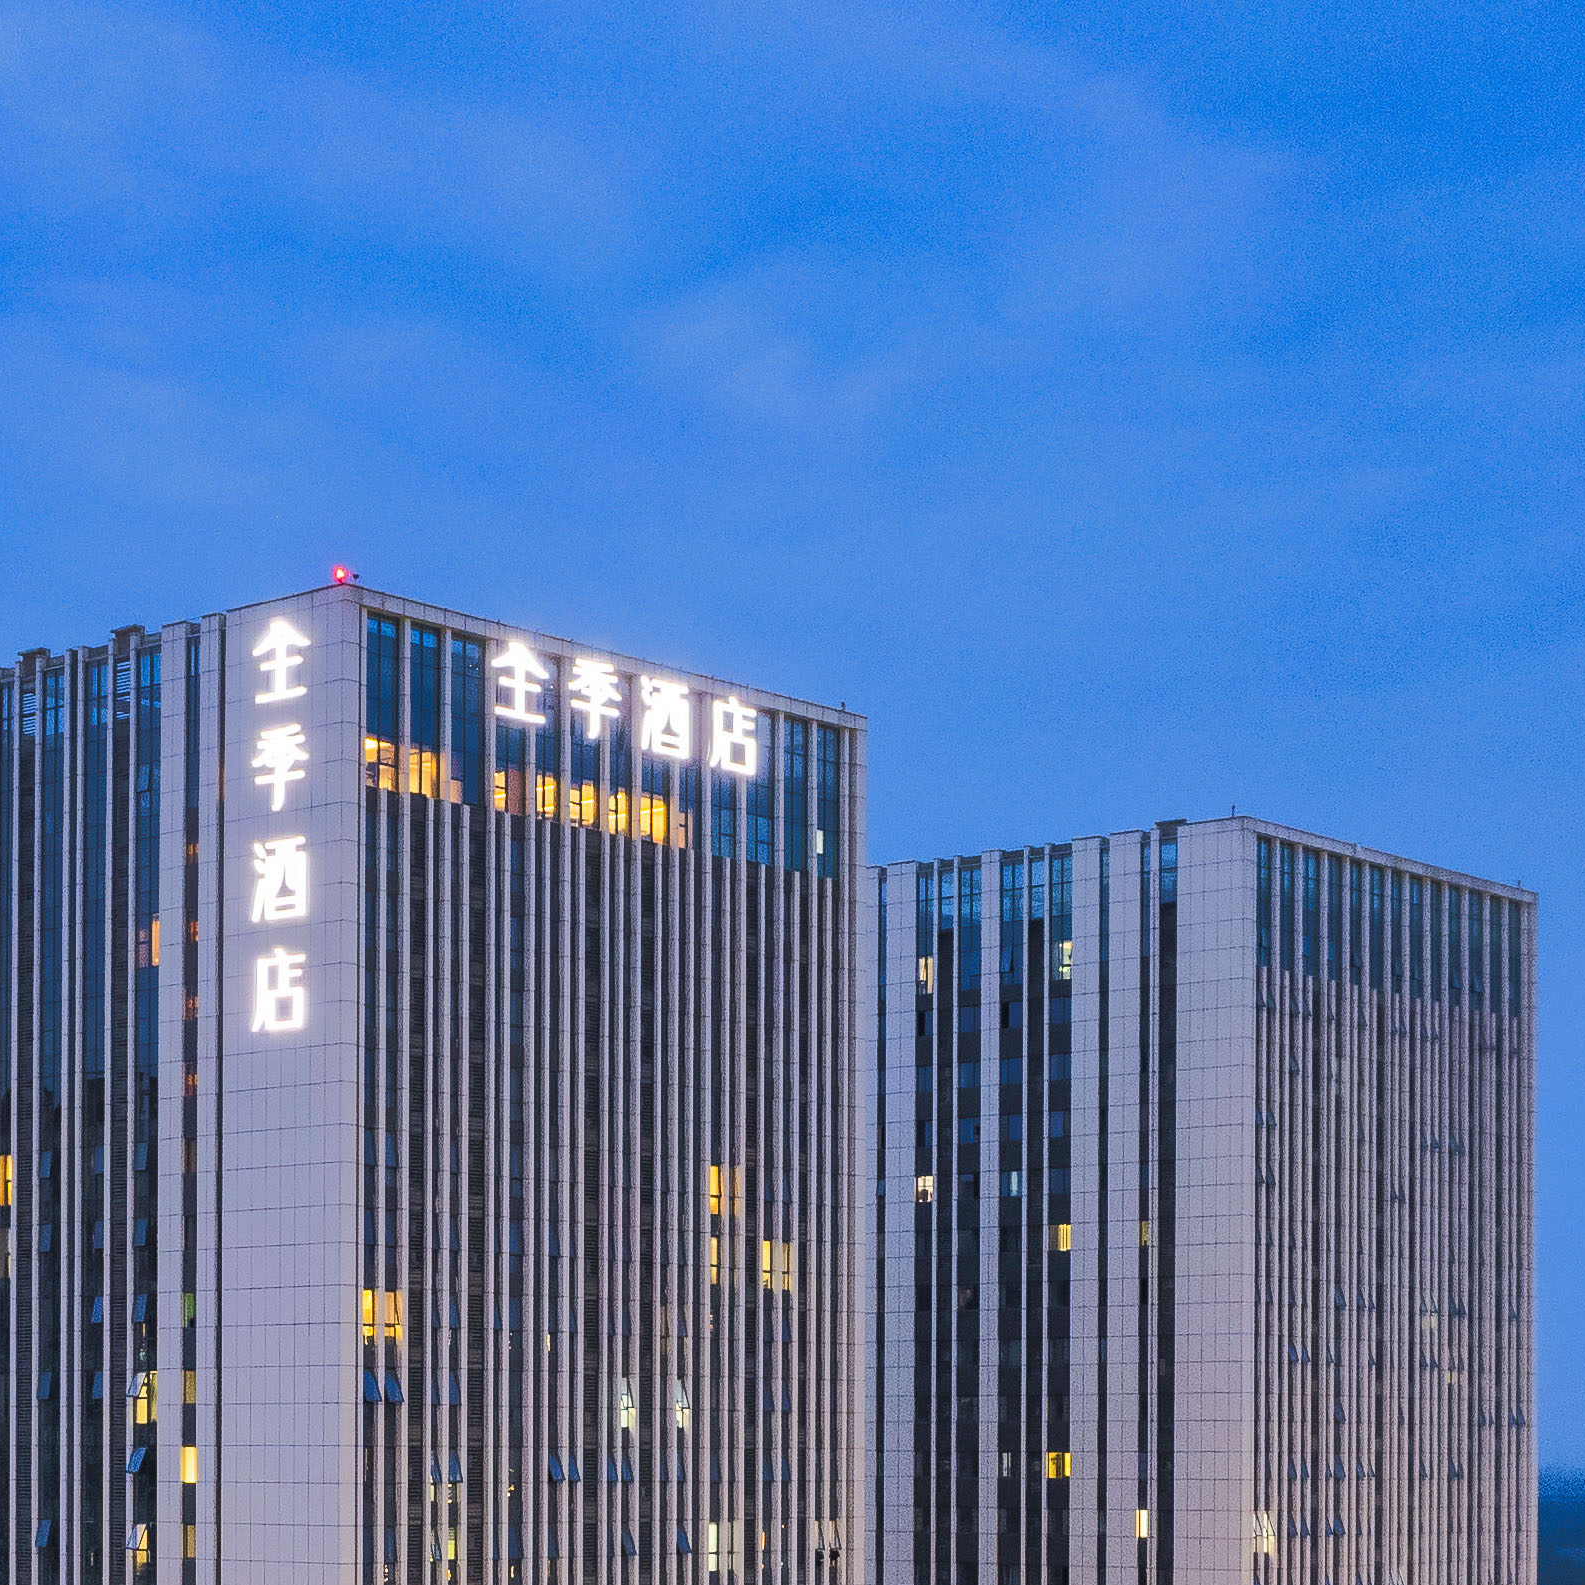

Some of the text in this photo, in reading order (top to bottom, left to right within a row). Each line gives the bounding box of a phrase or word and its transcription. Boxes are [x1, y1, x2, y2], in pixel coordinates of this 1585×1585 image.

[251, 619, 311, 1033] 全季酒店
[491, 641, 757, 776] 全季酒店
